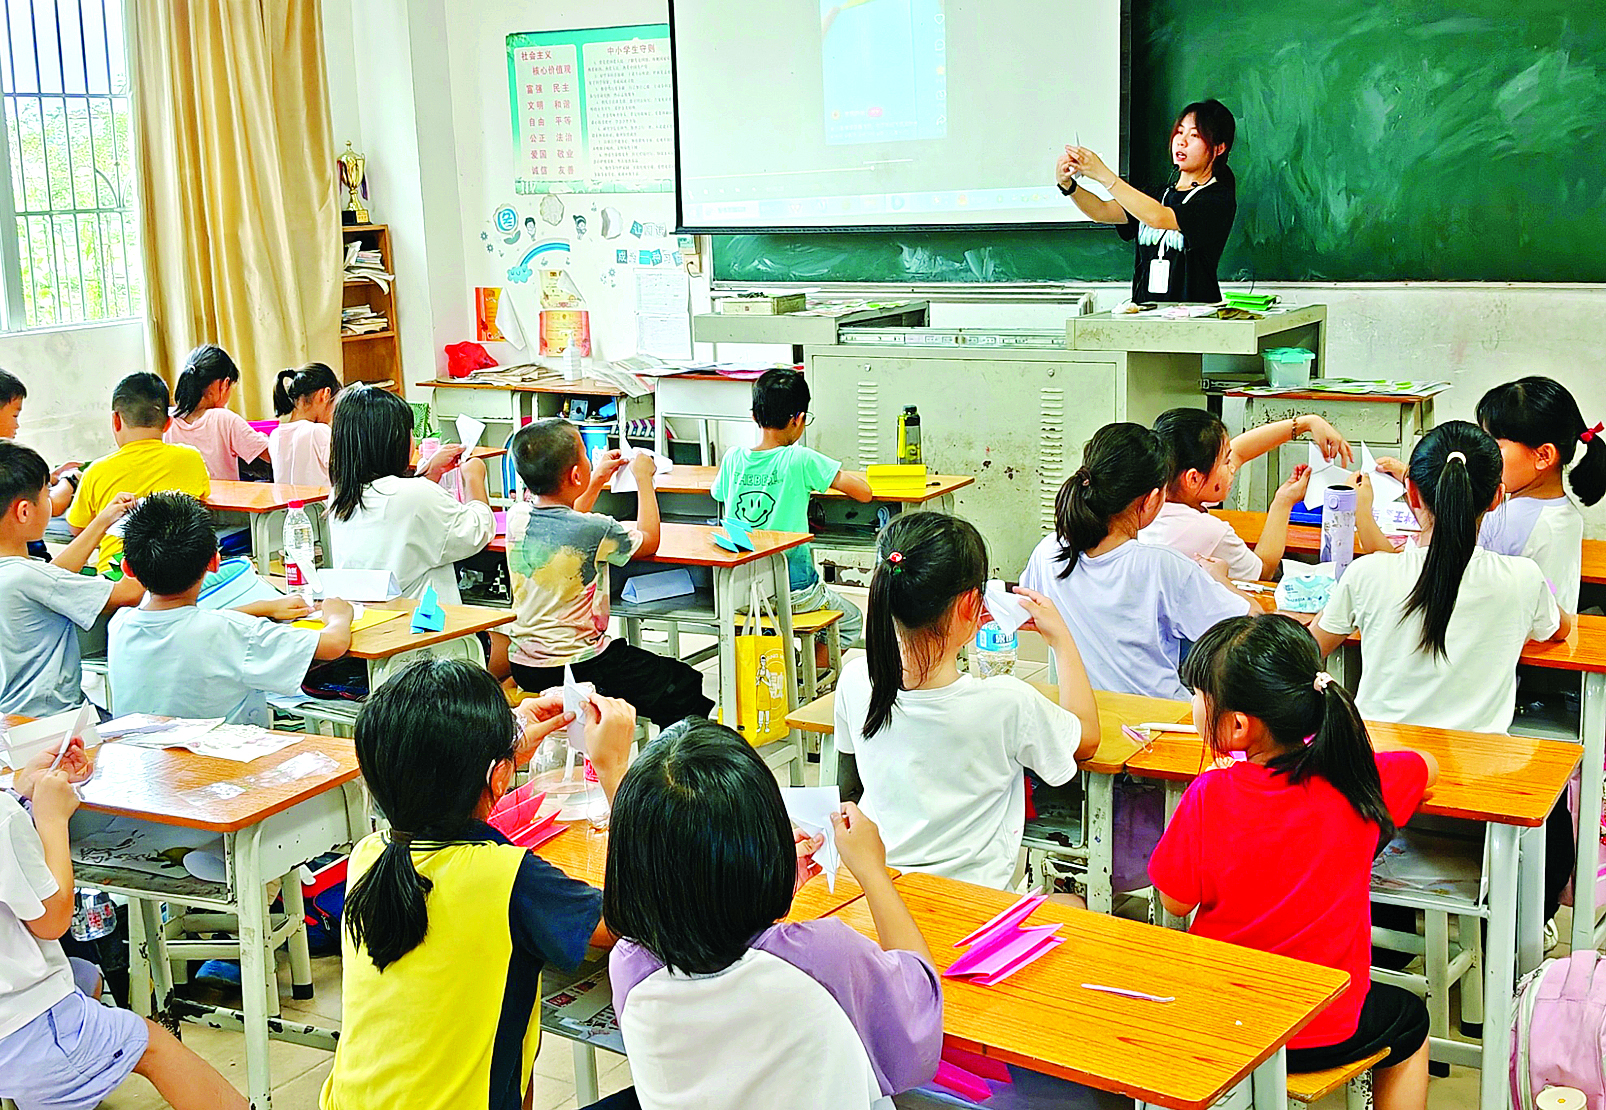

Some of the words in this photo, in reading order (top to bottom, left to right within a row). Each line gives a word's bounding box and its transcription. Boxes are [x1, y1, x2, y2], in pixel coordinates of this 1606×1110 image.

[607, 44, 655, 55] 中小学生守则
[521, 50, 552, 61] 社会主义
[532, 64, 571, 75] 核心价值观
[526, 84, 543, 94] 富强
[552, 83, 570, 93] 民主
[527, 100, 544, 110] 文明
[554, 99, 571, 109] 和谐
[529, 117, 545, 127] 自由
[555, 116, 571, 126] 平等
[529, 133, 546, 143] 公正
[555, 132, 573, 142] 法治
[530, 149, 547, 159] 爱国
[556, 149, 574, 159] 敬业
[531, 165, 548, 175] 诚信
[558, 165, 574, 175] 友善
